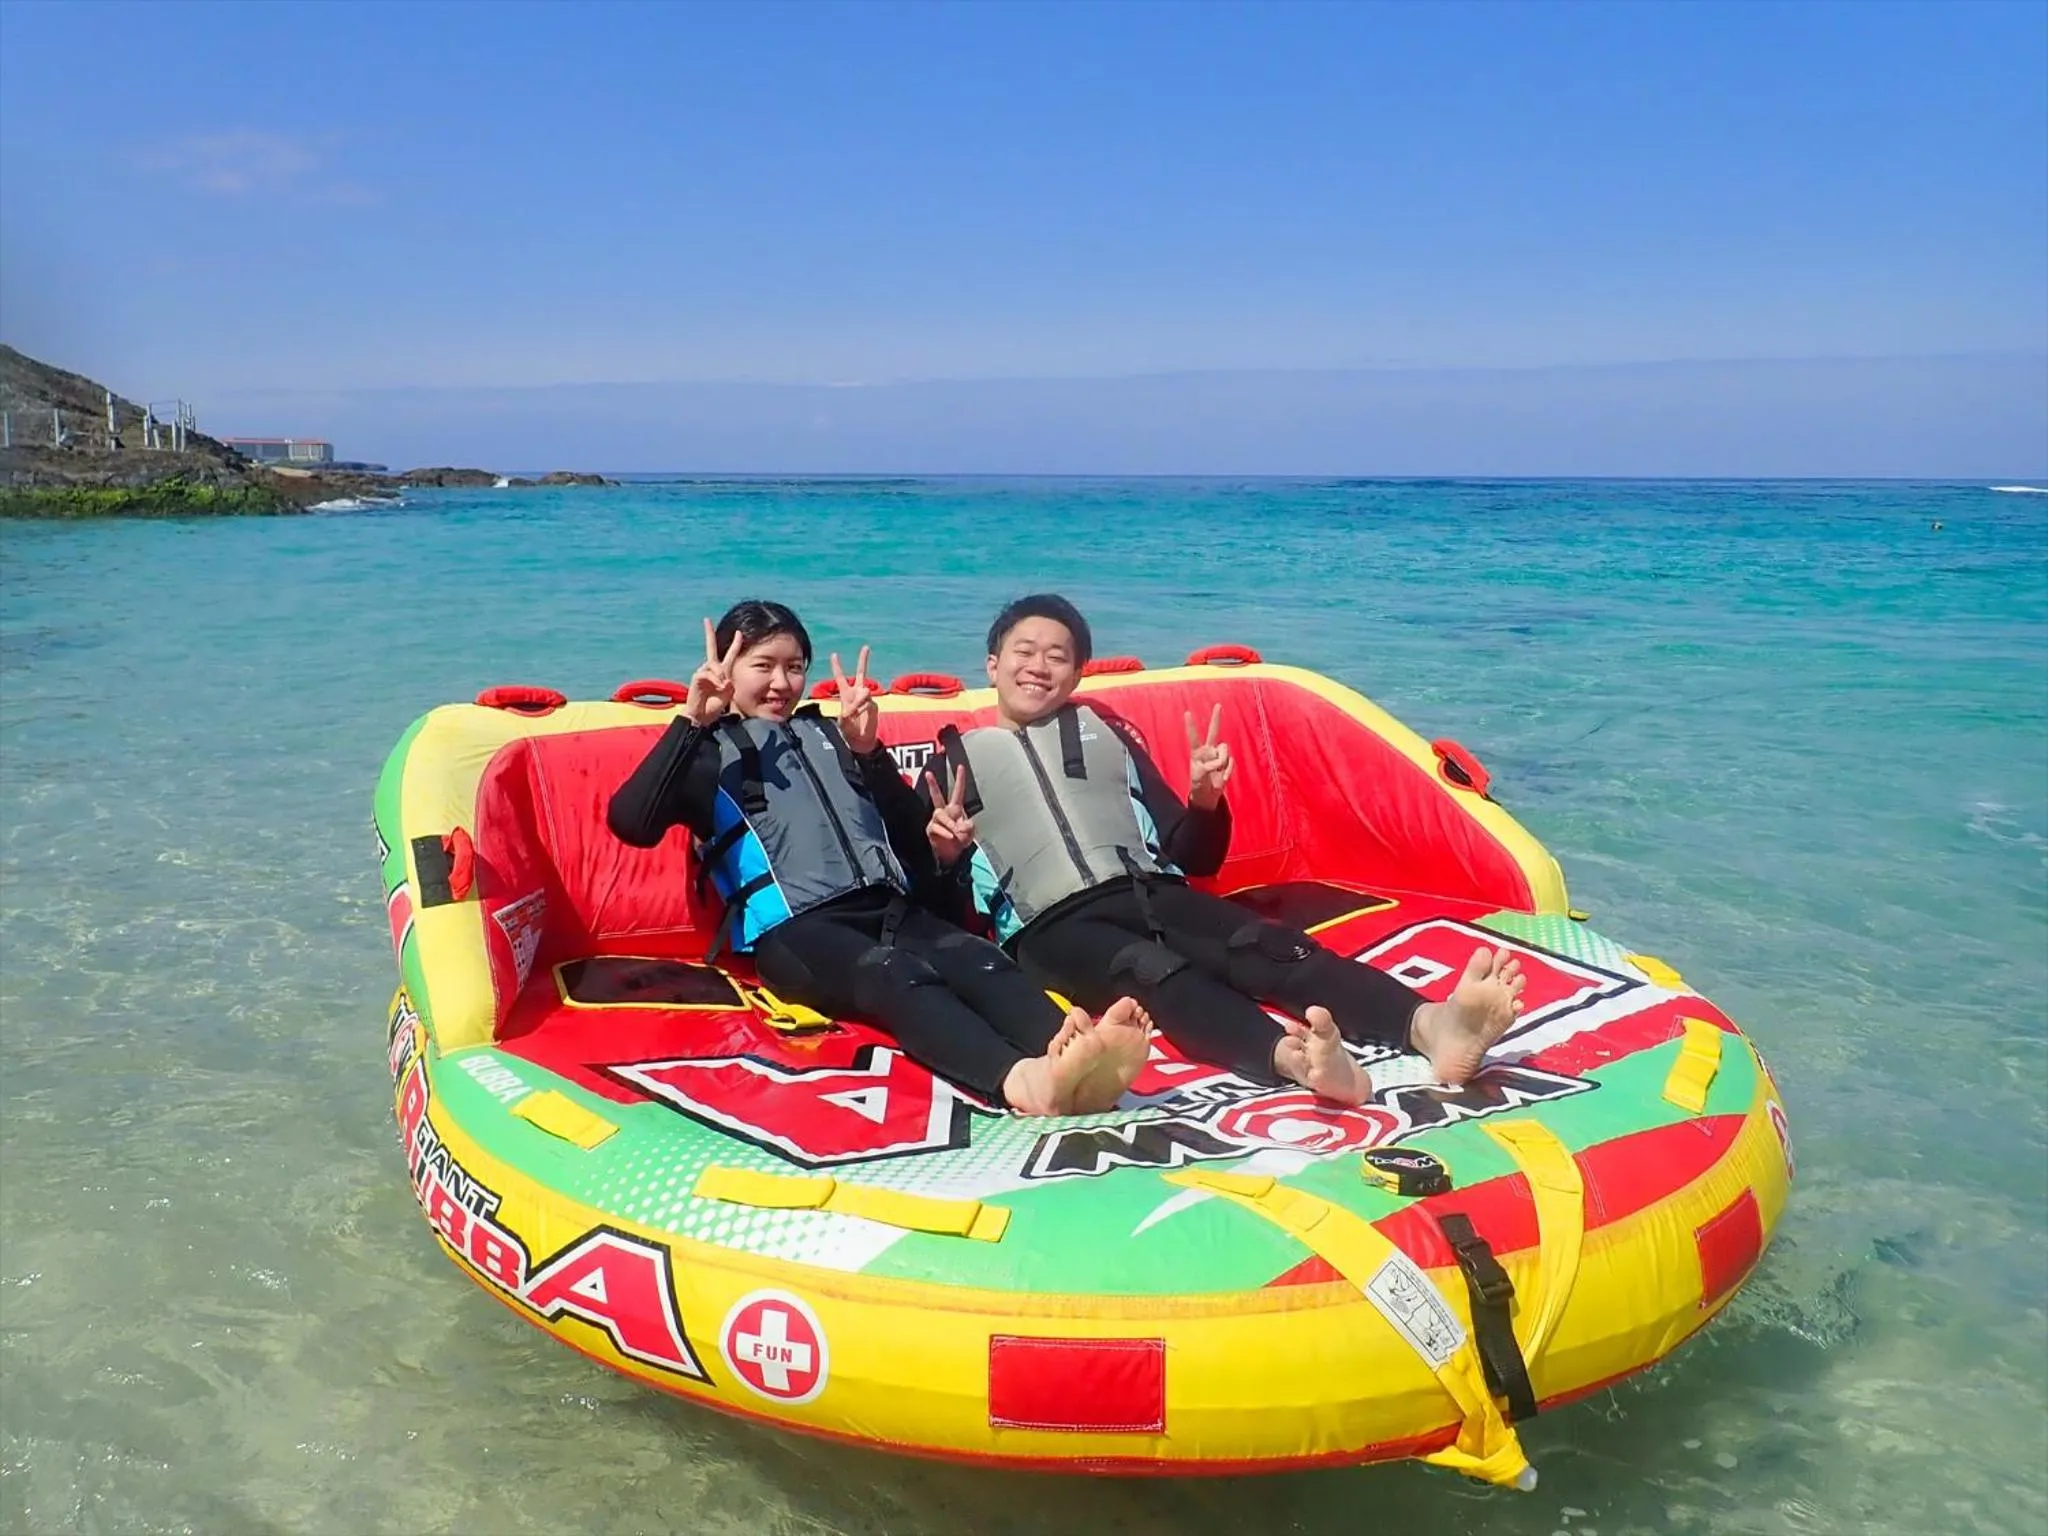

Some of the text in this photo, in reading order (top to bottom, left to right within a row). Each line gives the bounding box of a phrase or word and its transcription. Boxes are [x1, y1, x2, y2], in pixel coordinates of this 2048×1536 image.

[457, 1054, 533, 1104] BUBBA
[1022, 1064, 1598, 1178] WOW
[415, 1118, 499, 1217] GIANT
[753, 1343, 793, 1363] FUN
